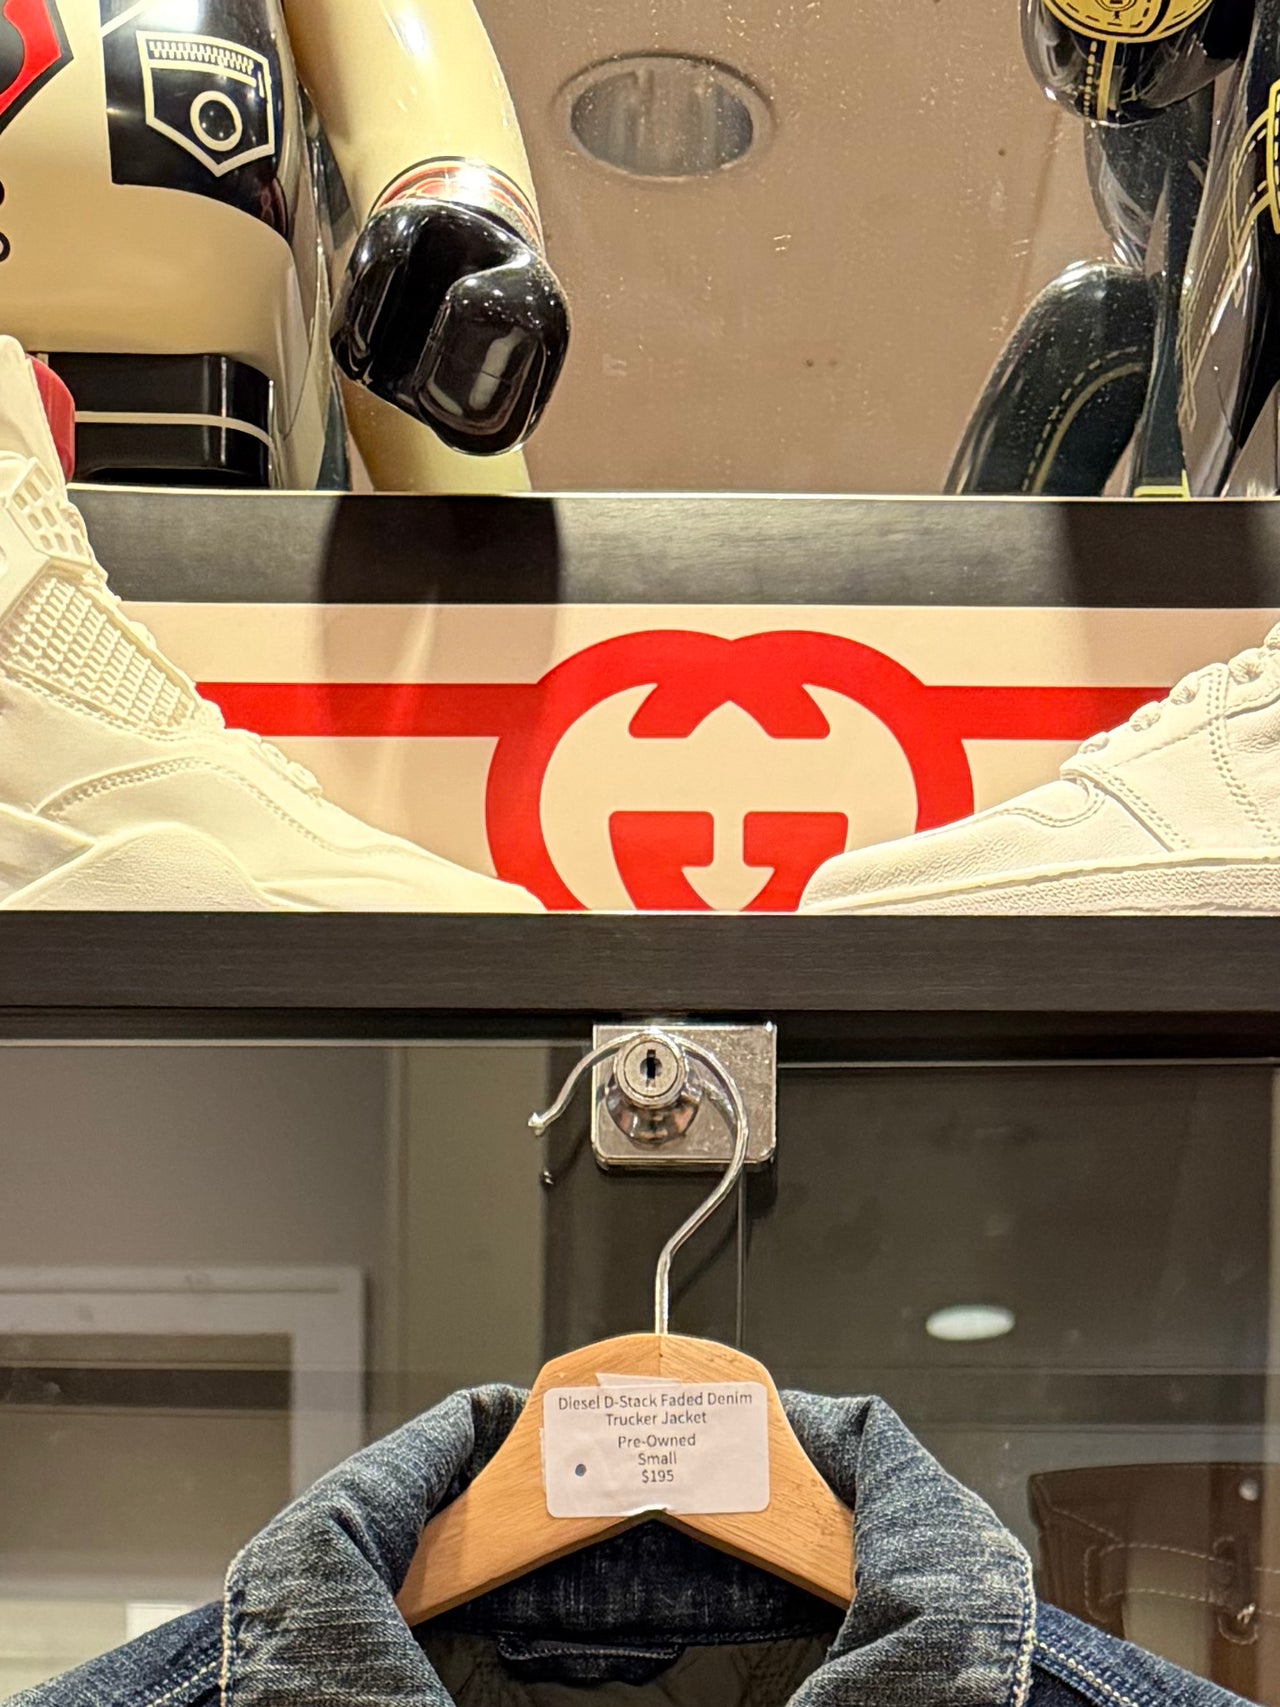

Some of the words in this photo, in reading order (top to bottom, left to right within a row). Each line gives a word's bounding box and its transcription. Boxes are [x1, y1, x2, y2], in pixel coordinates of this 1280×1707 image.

[558, 1395, 601, 1410] Diesel
[604, 1393, 658, 1409] D-Stack
[660, 1392, 704, 1407] Faded
[708, 1390, 753, 1406] Denim
[606, 1412, 657, 1427] Trucker
[661, 1411, 707, 1425] Jacket
[618, 1433, 696, 1449] Pre-Owned
[638, 1452, 678, 1466] Small
[641, 1469, 674, 1484] $195
